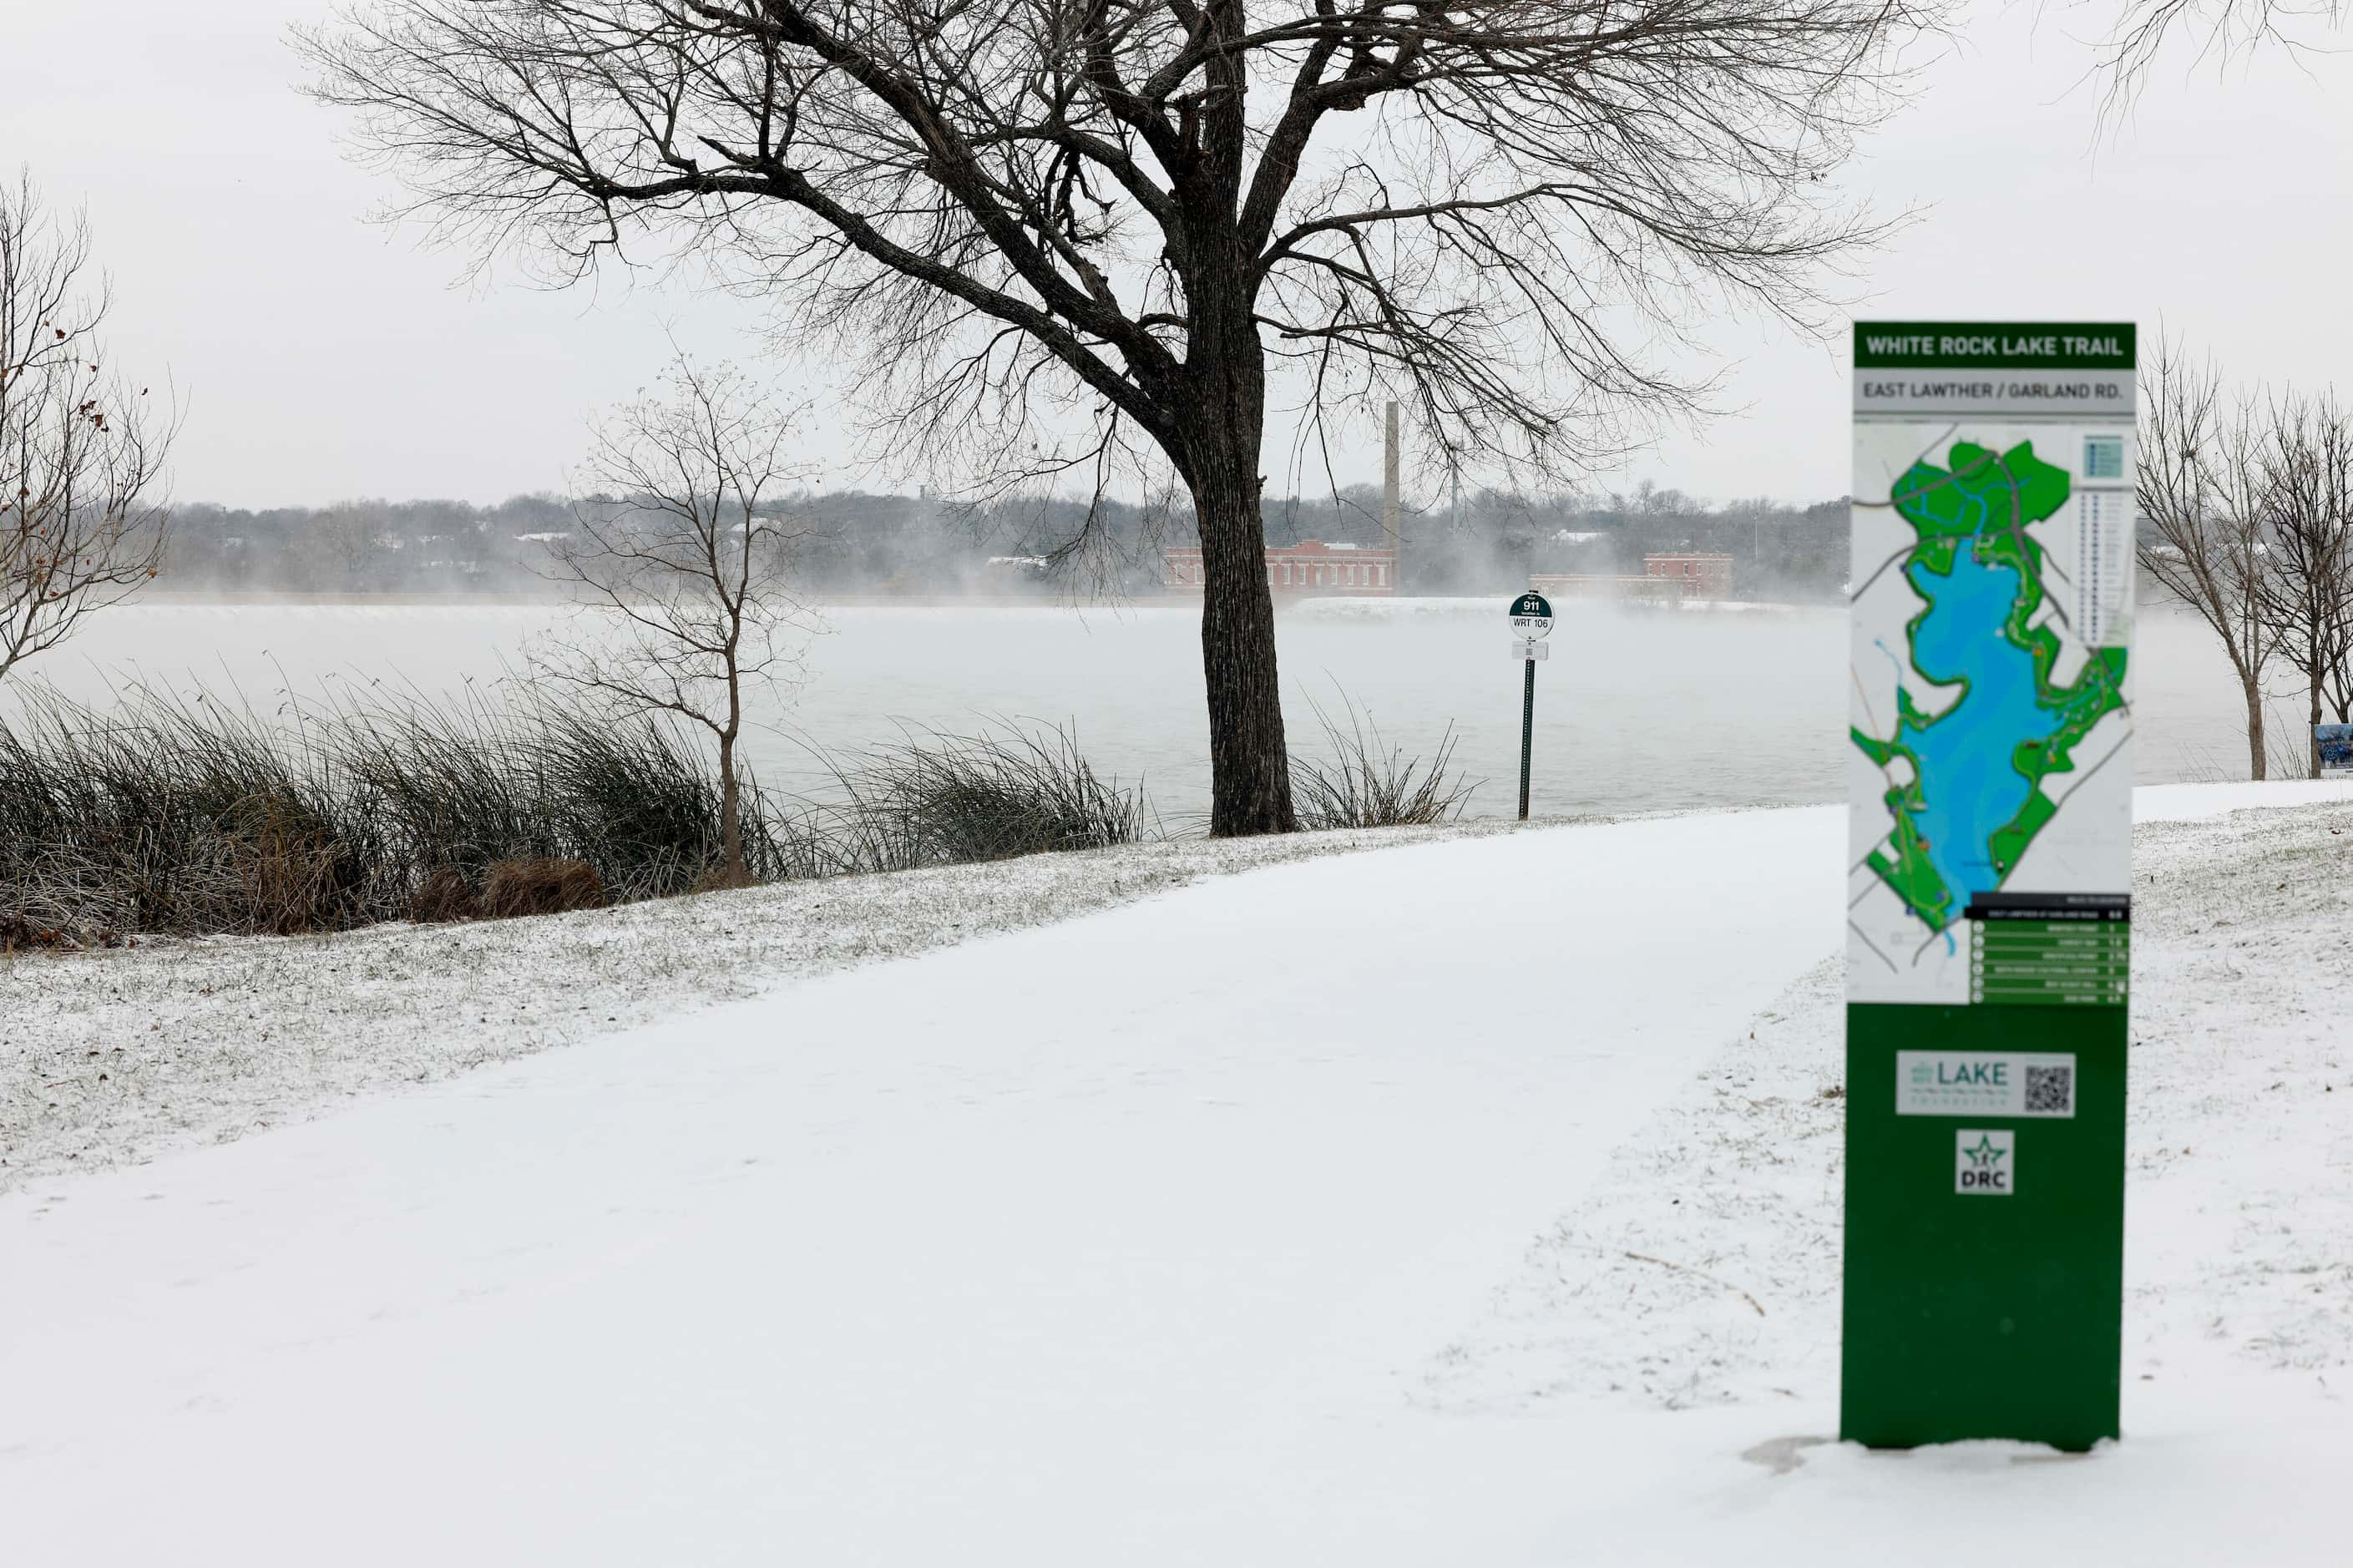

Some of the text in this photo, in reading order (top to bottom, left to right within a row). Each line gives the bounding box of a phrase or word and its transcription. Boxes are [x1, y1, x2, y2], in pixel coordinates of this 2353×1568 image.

[1866, 336, 2123, 356] WHITE ROCK LAKE TRAIL
[1864, 382, 1905, 398] EAST
[1911, 382, 1992, 398] LAWTHER
[2009, 383, 2089, 399] GARLAND
[2095, 384, 2123, 399] RD.
[1523, 601, 1539, 610] 911
[1514, 618, 1548, 628] WRT 106
[1937, 1061, 2009, 1085] LAKE
[1961, 1171, 2006, 1187] DRC
